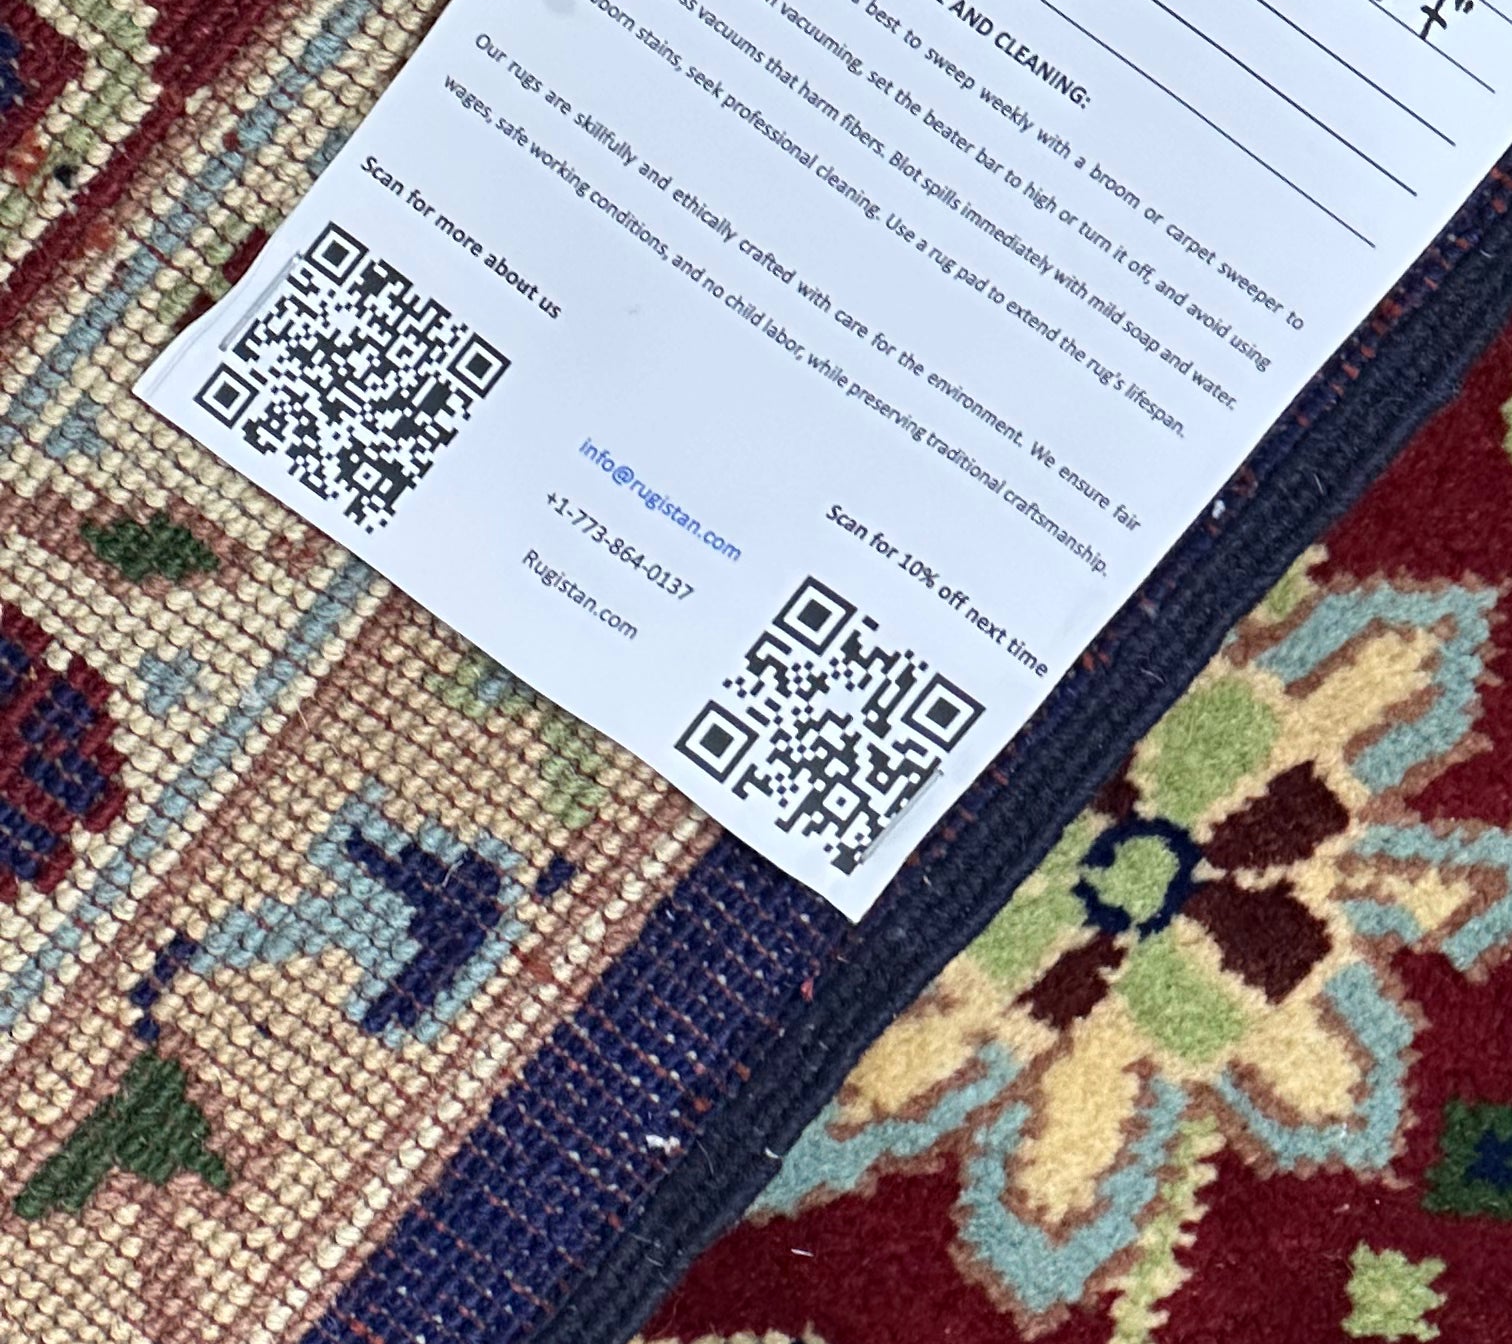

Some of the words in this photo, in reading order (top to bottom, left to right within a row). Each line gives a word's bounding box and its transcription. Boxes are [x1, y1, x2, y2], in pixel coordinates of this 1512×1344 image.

[779, 0, 863, 76] vacuuming,
[865, 69, 894, 96] set
[893, 87, 922, 117] the
[921, 107, 976, 154] beater
[973, 145, 1005, 174] bar
[1002, 168, 1022, 189] to
[1021, 179, 1058, 214] high
[1057, 208, 1079, 226] or
[1077, 220, 1112, 253] turn
[1111, 244, 1128, 264] it
[1126, 259, 1157, 285] off,
[1153, 279, 1190, 307] and
[1185, 302, 1233, 339] avoid
[1228, 333, 1272, 373] using
[902, 28, 923, 50] to
[923, 46, 976, 90] sweep
[978, 86, 1035, 134] weekly
[1035, 127, 1071, 160] with
[1072, 155, 1087, 170] a
[1087, 161, 1141, 210] broom
[1142, 206, 1165, 225] or
[1164, 223, 1217, 266] carpet
[1215, 261, 1285, 314] sweeper
[1284, 309, 1304, 331] to
[993, 30, 1092, 110] CLEANING:
[359, 154, 405, 197] Scan
[404, 187, 436, 218] for
[433, 213, 483, 258] more
[482, 252, 539, 302] about
[537, 295, 562, 320] us
[443, 73, 493, 124] wages,
[494, 116, 529, 147] safe
[528, 140, 591, 198] working
[588, 189, 669, 261] conditions,
[670, 253, 707, 283] and
[700, 276, 725, 299] no
[723, 293, 766, 327] child
[760, 317, 806, 361] labor,
[806, 351, 849, 389] while
[844, 381, 928, 442] preserving
[925, 431, 1007, 495] traditional
[1002, 488, 1107, 578] craftsmanship.
[474, 32, 508, 63] Our
[506, 59, 544, 93] rugs
[543, 89, 572, 116] are
[572, 111, 638, 167] skillfully
[637, 160, 673, 191] and
[671, 187, 738, 244] ethically
[737, 238, 797, 285] crafted
[796, 279, 832, 313] with
[833, 308, 869, 339] care
[869, 331, 897, 356] for
[896, 350, 925, 377] the
[926, 372, 1023, 448] environment.
[1029, 439, 1056, 469] We
[1057, 465, 1111, 510] ensure
[1111, 502, 1142, 531] fair
[634, 26, 683, 72] stains,
[684, 64, 724, 99] seek
[719, 92, 819, 169] professional
[814, 164, 881, 221] cleaning.
[884, 211, 916, 243] Use
[914, 237, 928, 253] a
[927, 246, 958, 274] rug
[952, 265, 990, 293] pad
[986, 285, 1006, 305] to
[1004, 299, 1062, 342] extend
[1058, 335, 1087, 363] the
[1085, 357, 1126, 391] rug's
[1123, 382, 1184, 439] lifespan.
[697, 4, 766, 64] vacuums
[763, 56, 799, 90] that
[796, 79, 840, 122] harm
[838, 112, 886, 159] fibers.
[887, 149, 923, 183] Blot
[919, 176, 962, 211] spills
[958, 200, 1054, 276] immediately
[1052, 267, 1088, 300] with
[1086, 294, 1127, 325] mild
[1120, 319, 1161, 353] soap
[1158, 347, 1195, 376] and
[1190, 369, 1237, 411] water.
[520, 547, 638, 640] Rugistan.com
[546, 491, 695, 601] +1-773-864-0137
[577, 436, 742, 562] info@rugistan.com
[824, 503, 869, 541] Scan
[867, 530, 900, 559] for
[896, 552, 941, 590] 10%
[936, 584, 970, 611] off
[963, 606, 1007, 646] next
[1005, 636, 1049, 678] time
